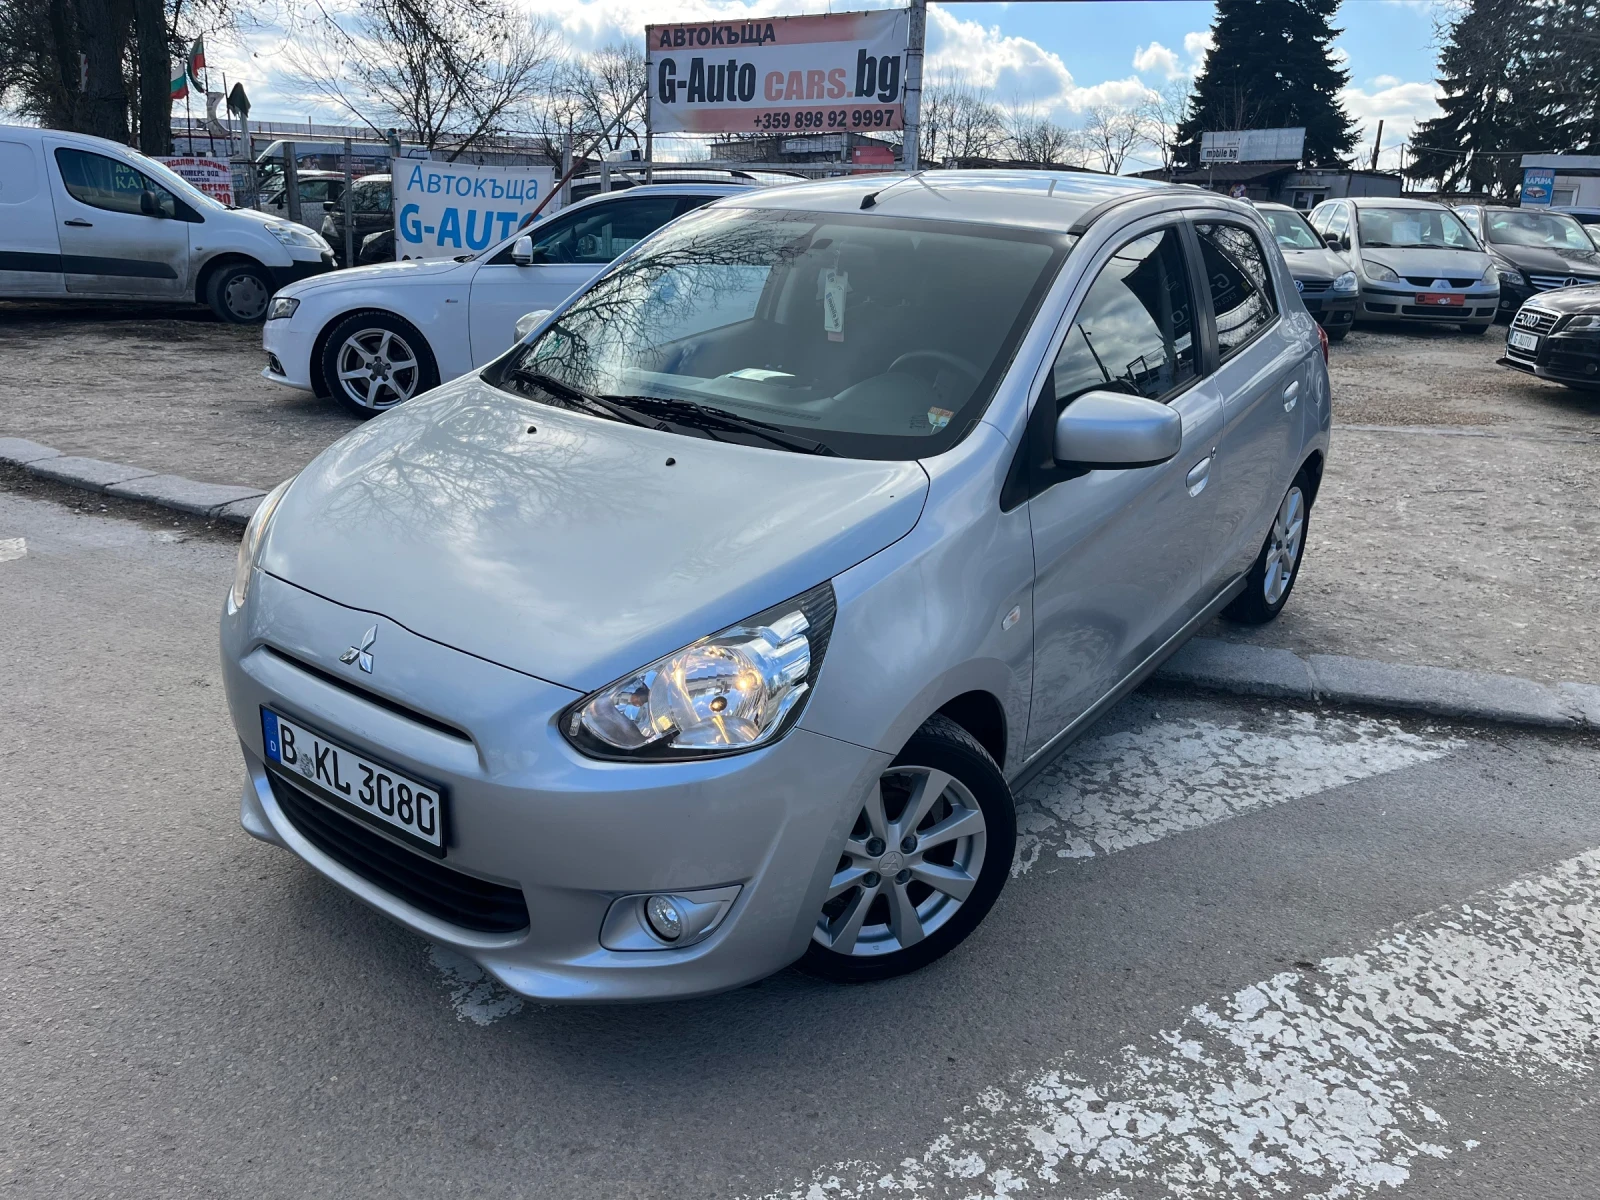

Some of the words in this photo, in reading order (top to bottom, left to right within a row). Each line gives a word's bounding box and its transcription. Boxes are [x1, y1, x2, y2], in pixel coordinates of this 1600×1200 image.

[659, 23, 776, 47] АВТОКЪЩА
[658, 57, 756, 104] G-Auto
[753, 112, 790, 130] +359
[794, 111, 823, 129] 898
[828, 110, 847, 128] 92
[852, 109, 895, 127] 9997
[407, 165, 538, 205] Автокъща
[280, 724, 297, 765] B
[314, 741, 351, 795] KL
[358, 763, 435, 836] 3080
